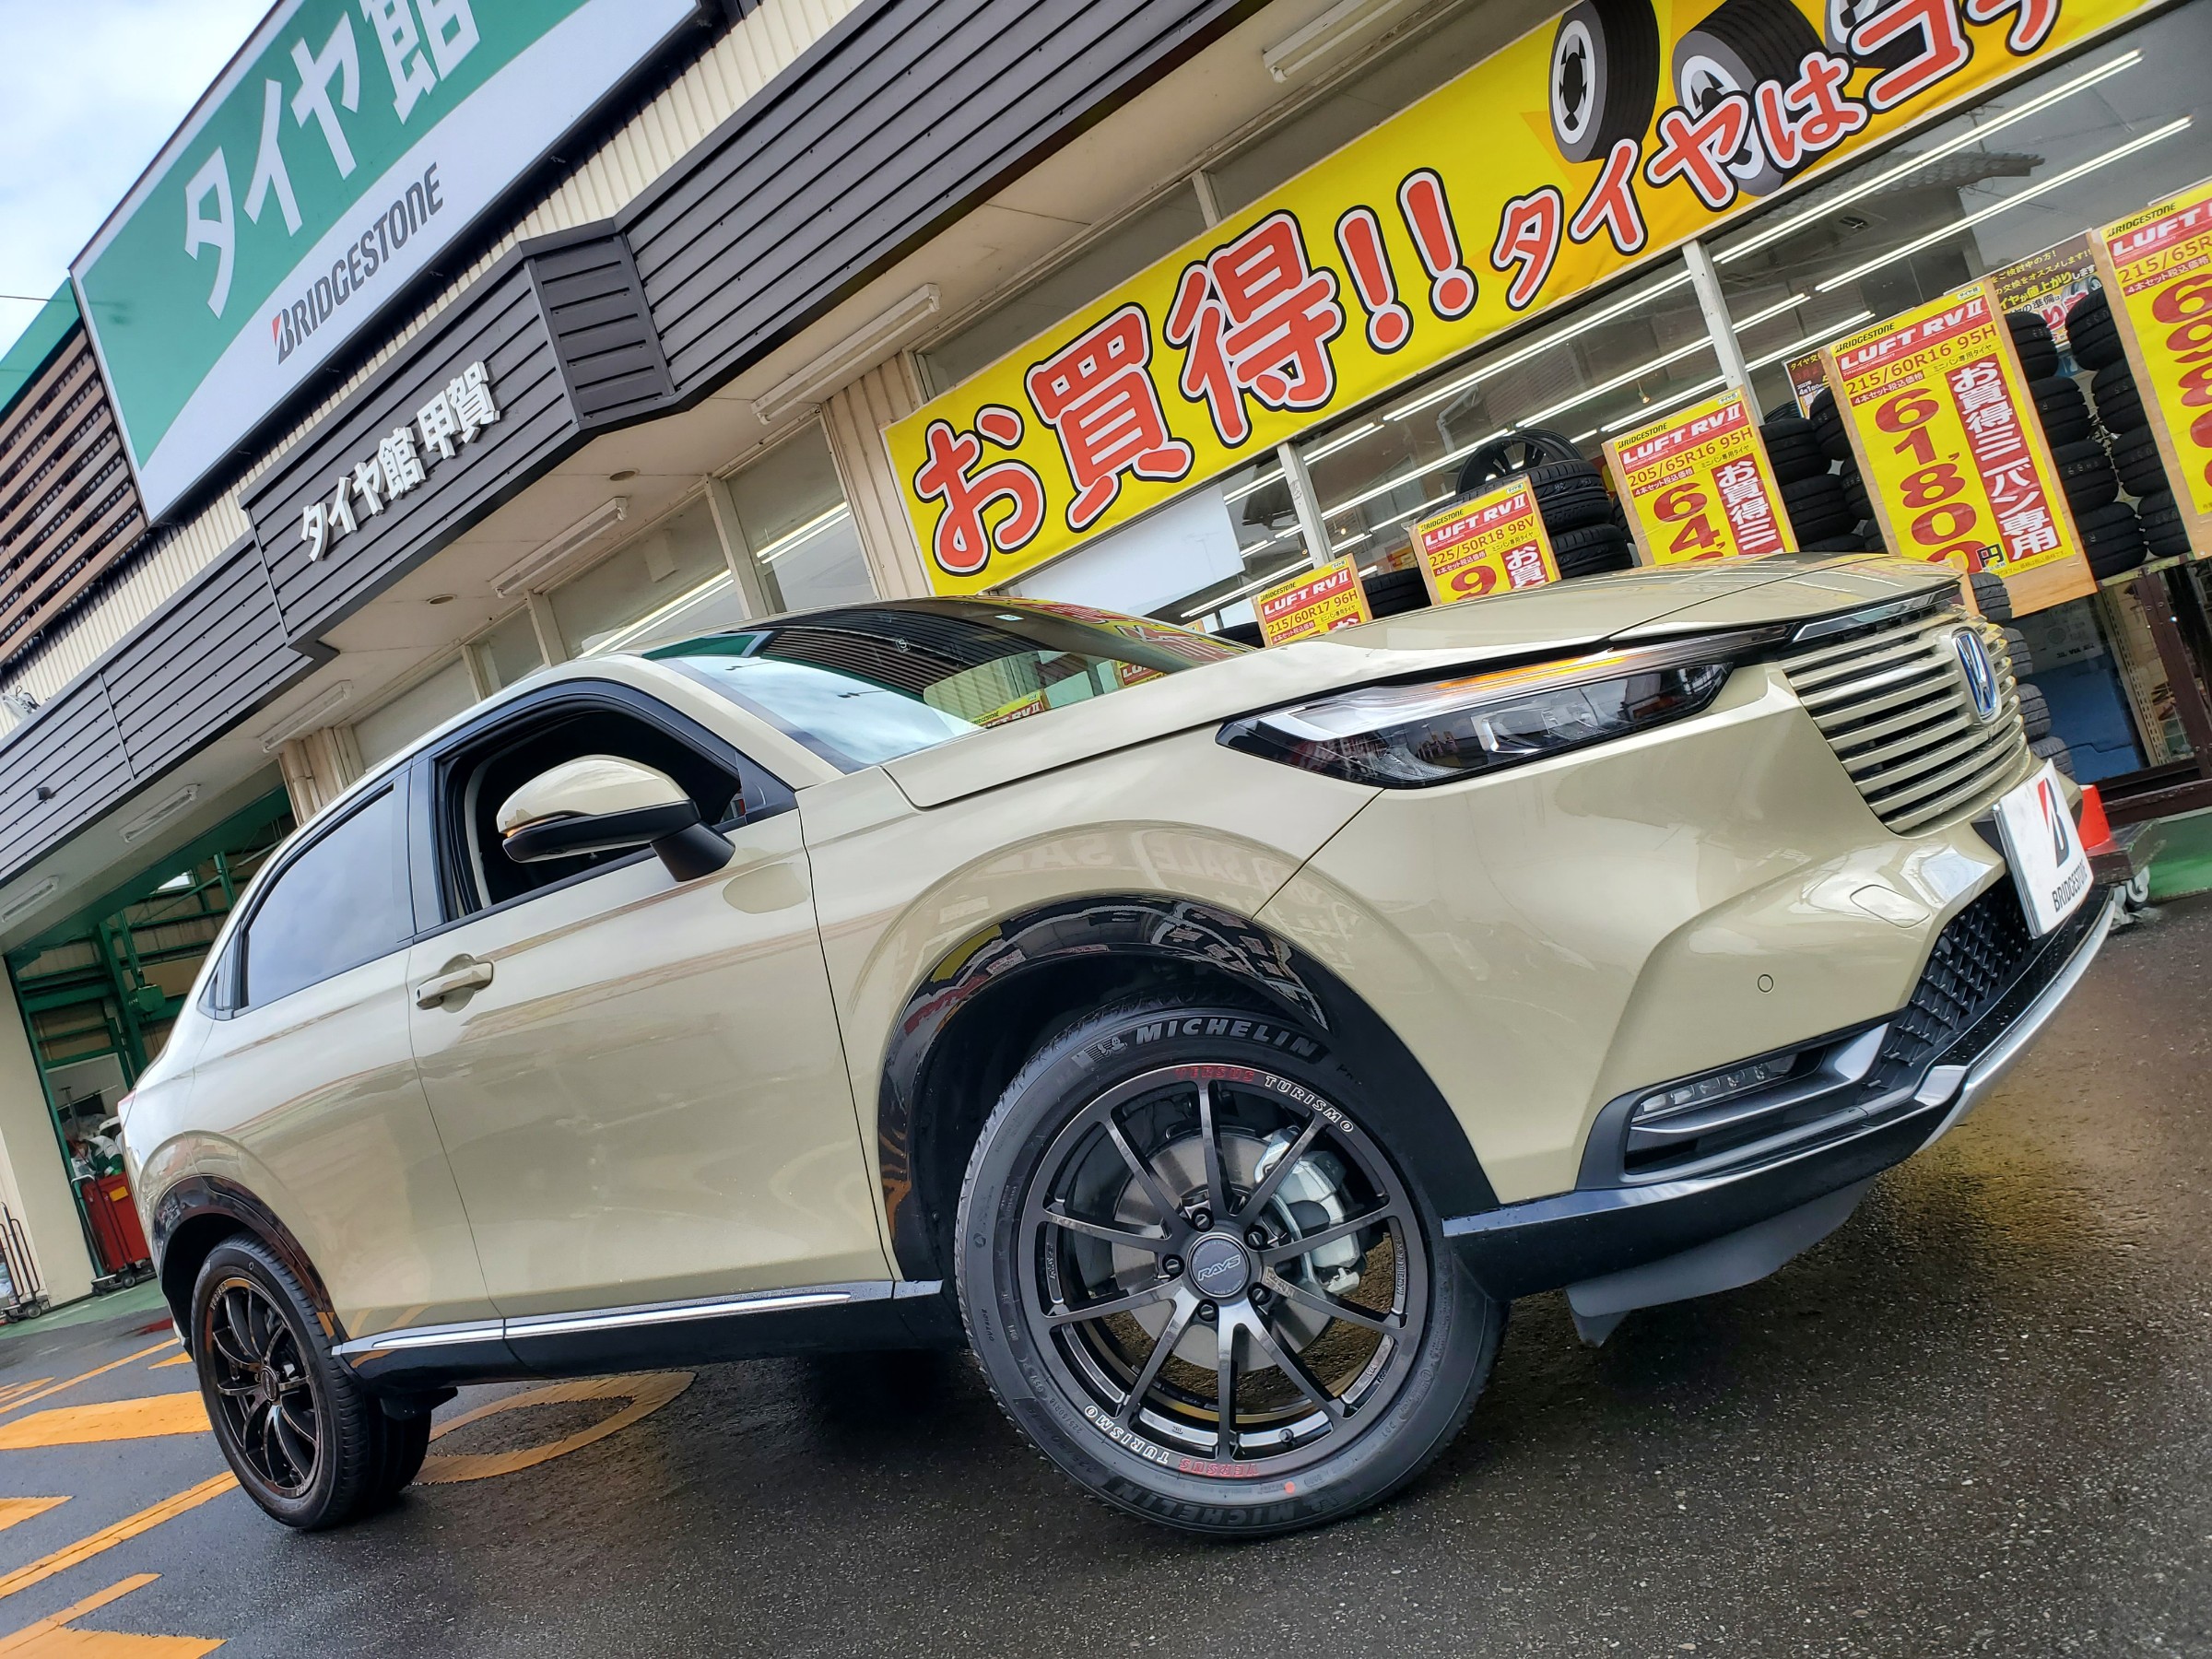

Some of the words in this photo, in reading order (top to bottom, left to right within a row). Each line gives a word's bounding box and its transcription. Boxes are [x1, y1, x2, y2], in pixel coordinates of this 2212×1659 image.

[184, 0, 480, 319] タイヤ館
[2107, 203, 2176, 238] BRIDGESTONE
[2112, 207, 2201, 256] LUFT
[273, 162, 444, 365] BRIDGESTONE
[1835, 323, 1895, 353] BRIDGESTONE
[1841, 328, 1916, 371] LUFT
[1933, 344, 1992, 372] ミニバン専用タイヤ
[1791, 352, 1820, 371] タイヤ交
[1846, 344, 1951, 395] 215/60R16
[1958, 324, 1997, 350] 95H
[1854, 371, 1924, 405] 4本セット税込価格
[1618, 422, 1667, 449] BRIDGESTONE
[1623, 429, 1687, 465] LUFT
[300, 427, 426, 561] タイヤ館
[417, 361, 500, 459] 甲賀
[1628, 443, 1716, 488] 205/65R16
[1720, 428, 1754, 449] 95H
[1951, 361, 2058, 560] お買得ミニバン専用
[1421, 509, 1464, 532] BRIDGESTONE
[1425, 514, 1481, 547] LUFT
[1430, 529, 1505, 567] 225/50R18
[1508, 516, 1535, 535] 98V
[1260, 582, 1296, 602] BRIDGESTONE
[1264, 588, 1310, 616] LUFT
[1267, 601, 1330, 634] 215/60R17
[1334, 590, 1359, 607] 96H
[1135, 1018, 1318, 1058] MICHELIN
[1174, 1065, 1255, 1082] VERSUS
[1264, 1075, 1354, 1134] TURISMO
[1198, 1254, 1242, 1281] RAYS
[1084, 1405, 1170, 1465] TURISMO
[1112, 1482, 1295, 1525] MICHELIN
